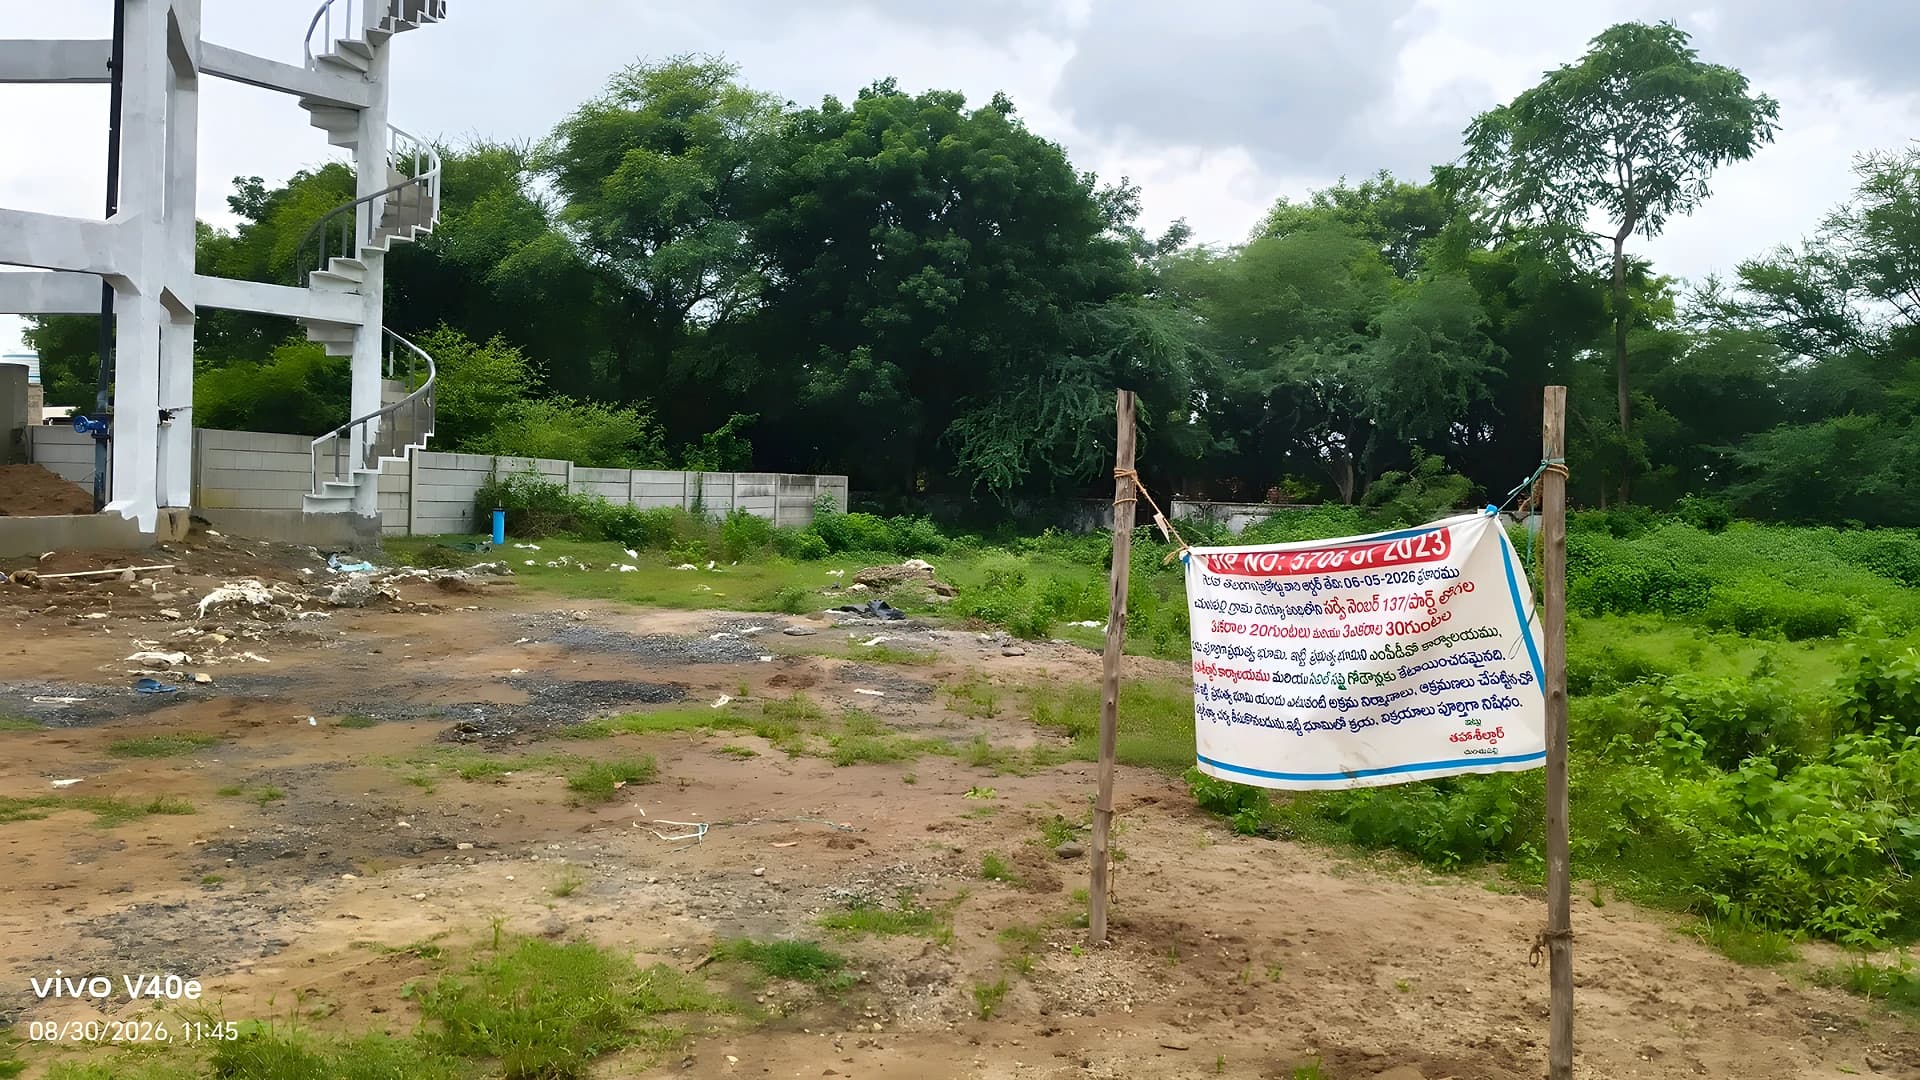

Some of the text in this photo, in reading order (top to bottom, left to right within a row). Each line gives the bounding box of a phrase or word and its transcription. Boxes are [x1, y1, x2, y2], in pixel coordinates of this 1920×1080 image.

[1291, 550, 1348, 571] 5706
[1383, 531, 1446, 562] 2023
[1344, 570, 1416, 589] 06-05-2026
[1323, 596, 1346, 620] సర్వే
[1347, 594, 1380, 613] నెంబర్
[1272, 671, 1309, 685] మరియు
[1328, 696, 1359, 712] అక్రమ
[1381, 706, 1435, 725] విక్రయాలు
[1437, 698, 1480, 717] పూర్తిగా
